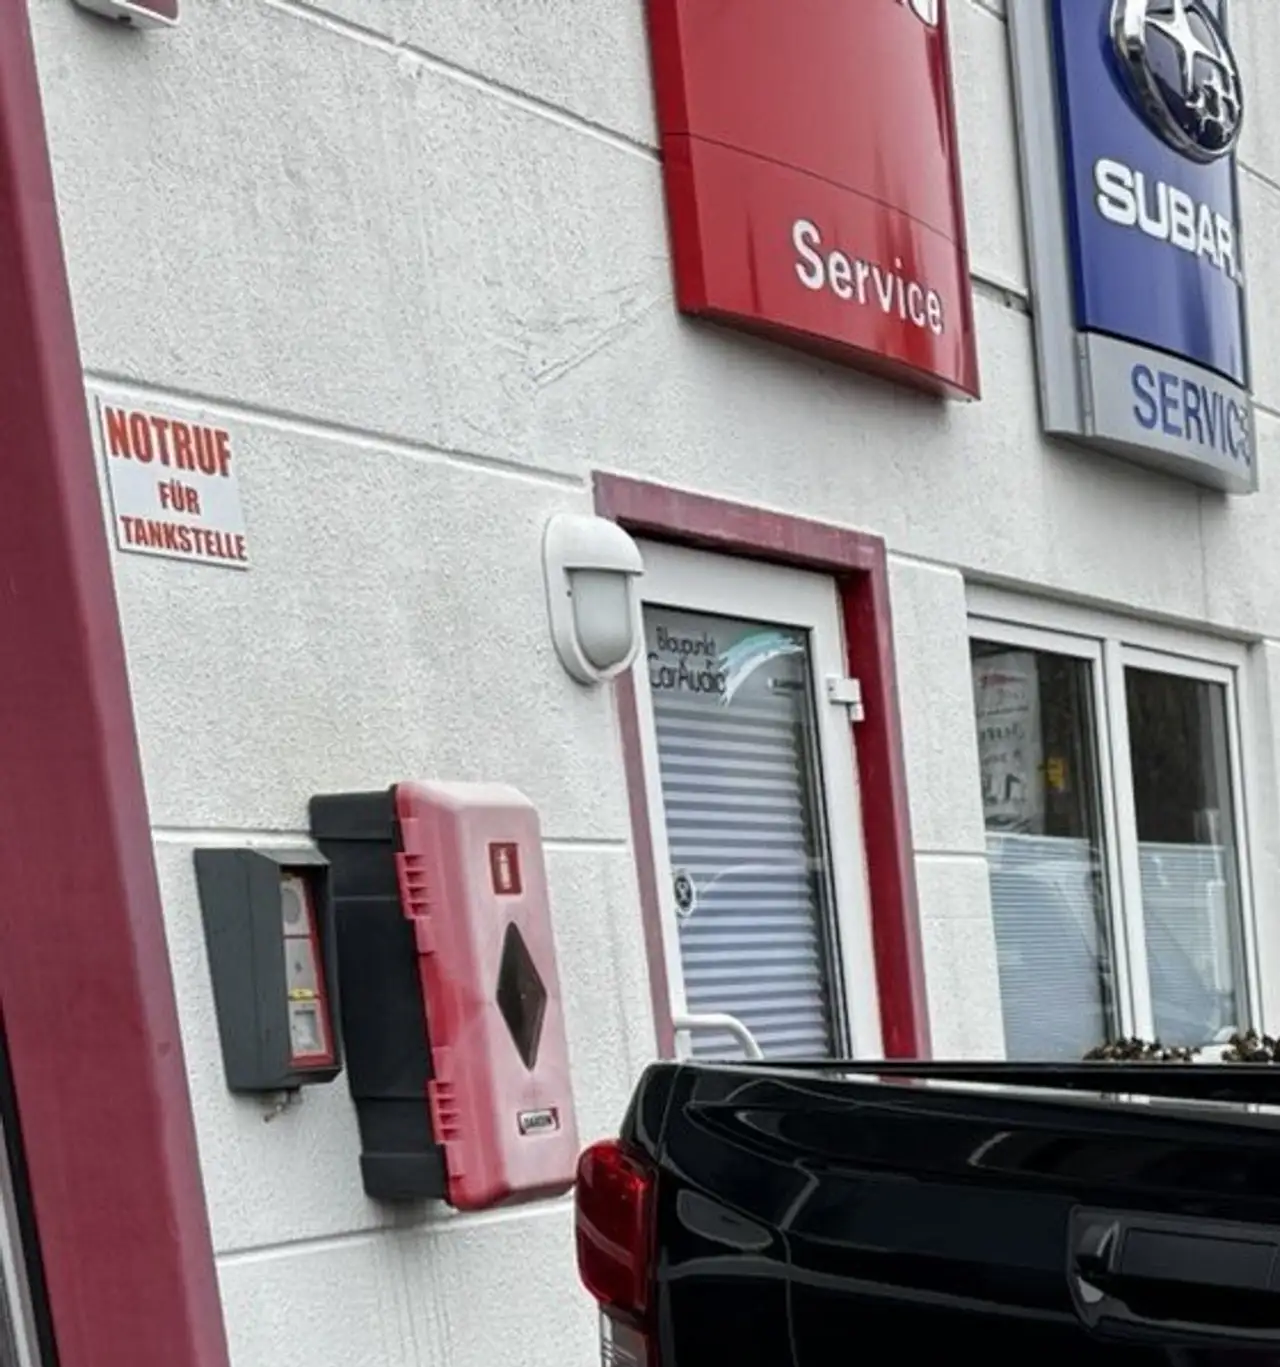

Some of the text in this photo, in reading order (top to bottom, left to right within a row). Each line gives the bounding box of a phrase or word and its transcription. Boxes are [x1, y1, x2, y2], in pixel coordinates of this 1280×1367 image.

[1094, 157, 1243, 285] SUBAR
[792, 219, 942, 336] Service
[104, 406, 231, 477] NOTRUF
[158, 478, 201, 515] FÜR
[119, 515, 248, 561] TANKSTELLE
